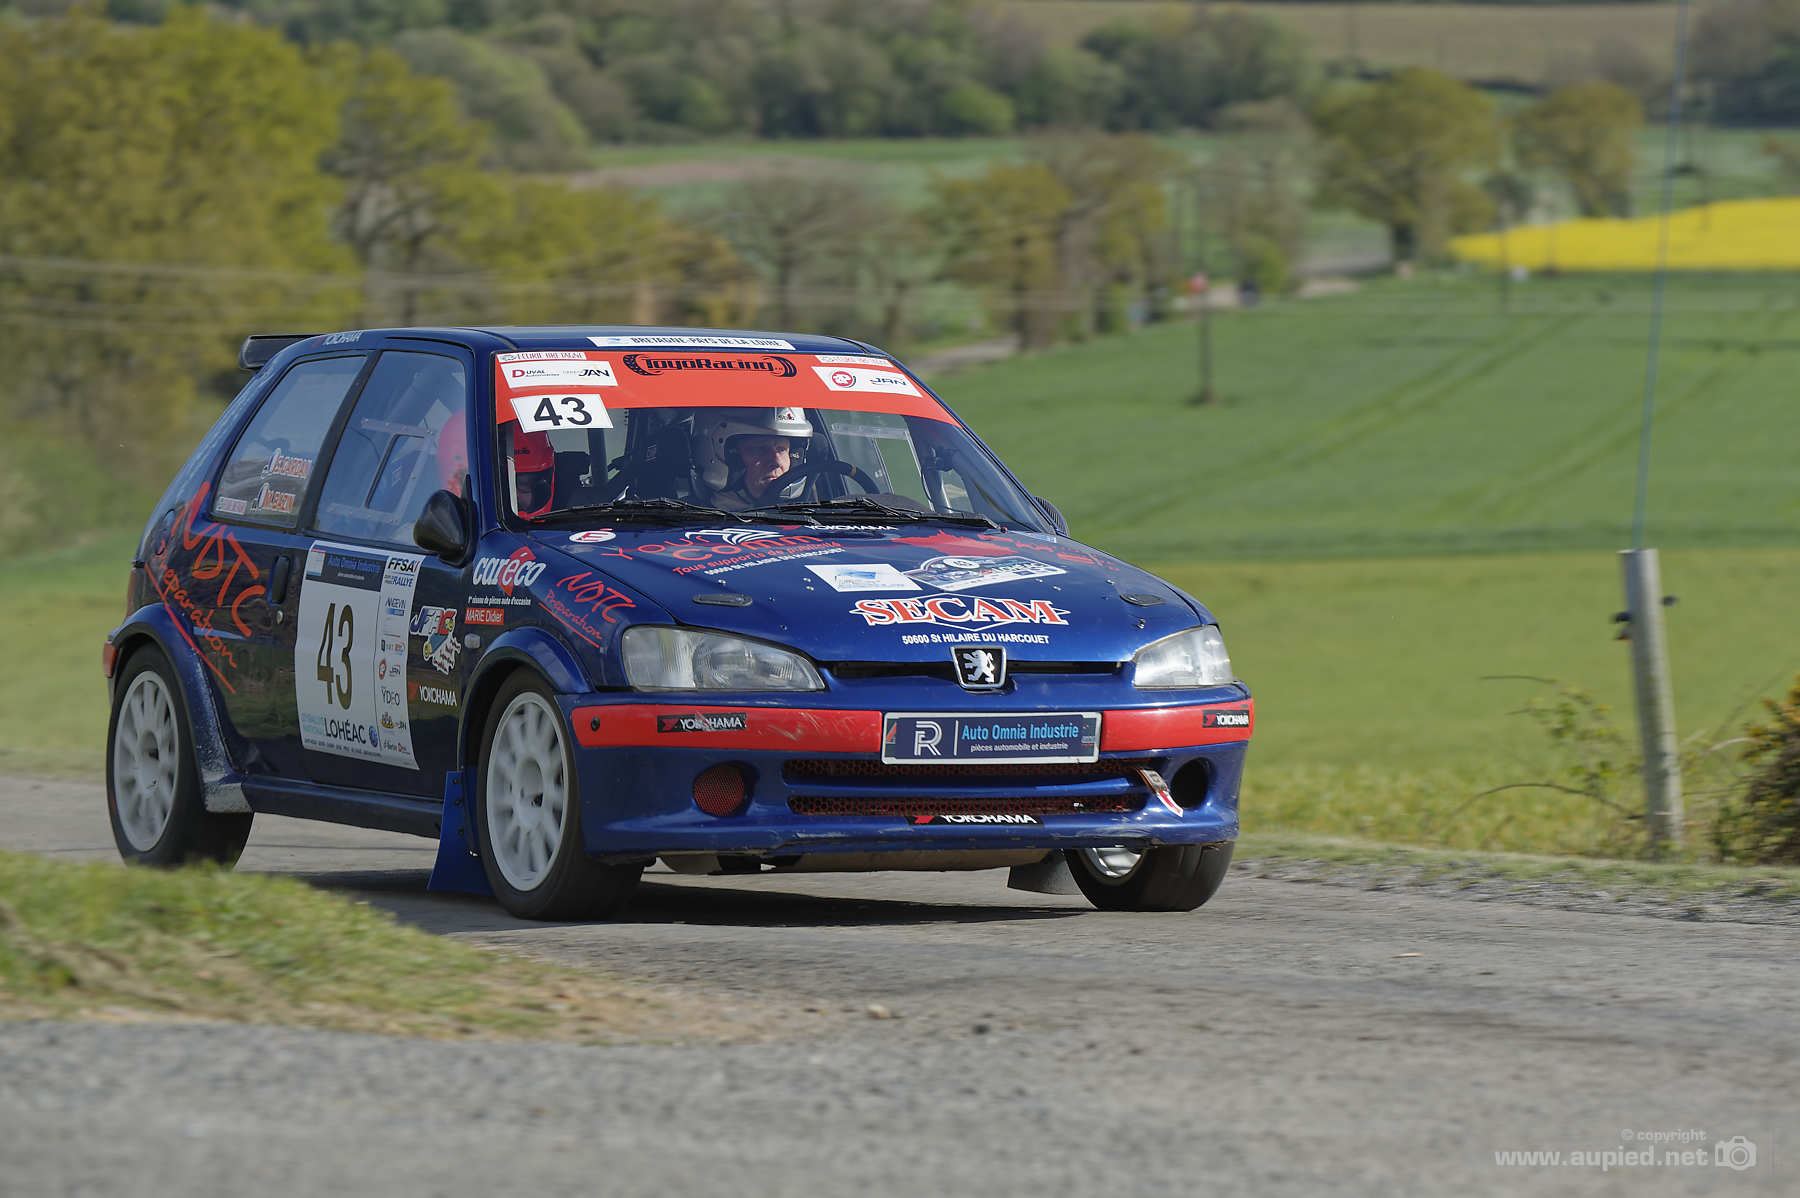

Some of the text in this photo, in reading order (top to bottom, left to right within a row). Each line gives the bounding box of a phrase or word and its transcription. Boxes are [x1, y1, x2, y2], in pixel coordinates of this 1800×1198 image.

[578, 369, 610, 377] JAN
[533, 396, 593, 426] 43
[387, 557, 416, 573] FFSA
[672, 563, 706, 577] Tous
[707, 552, 767, 570] supports
[392, 575, 414, 588] RALLYE
[466, 609, 485, 622] MARIE
[854, 597, 1070, 627] SECAM
[901, 633, 1050, 645] 50600 St HILAIRE DU HARCOUET
[316, 602, 354, 711] 43
[419, 685, 458, 707] YOKOHAMA
[1216, 714, 1249, 726] YOKOHAMA
[323, 716, 367, 745] LOHÉAC
[961, 722, 1080, 741] Auto Omnia Industrie
[970, 742, 1069, 753] pièces automobile et industrie
[940, 814, 1038, 824] YOKOHAMA
